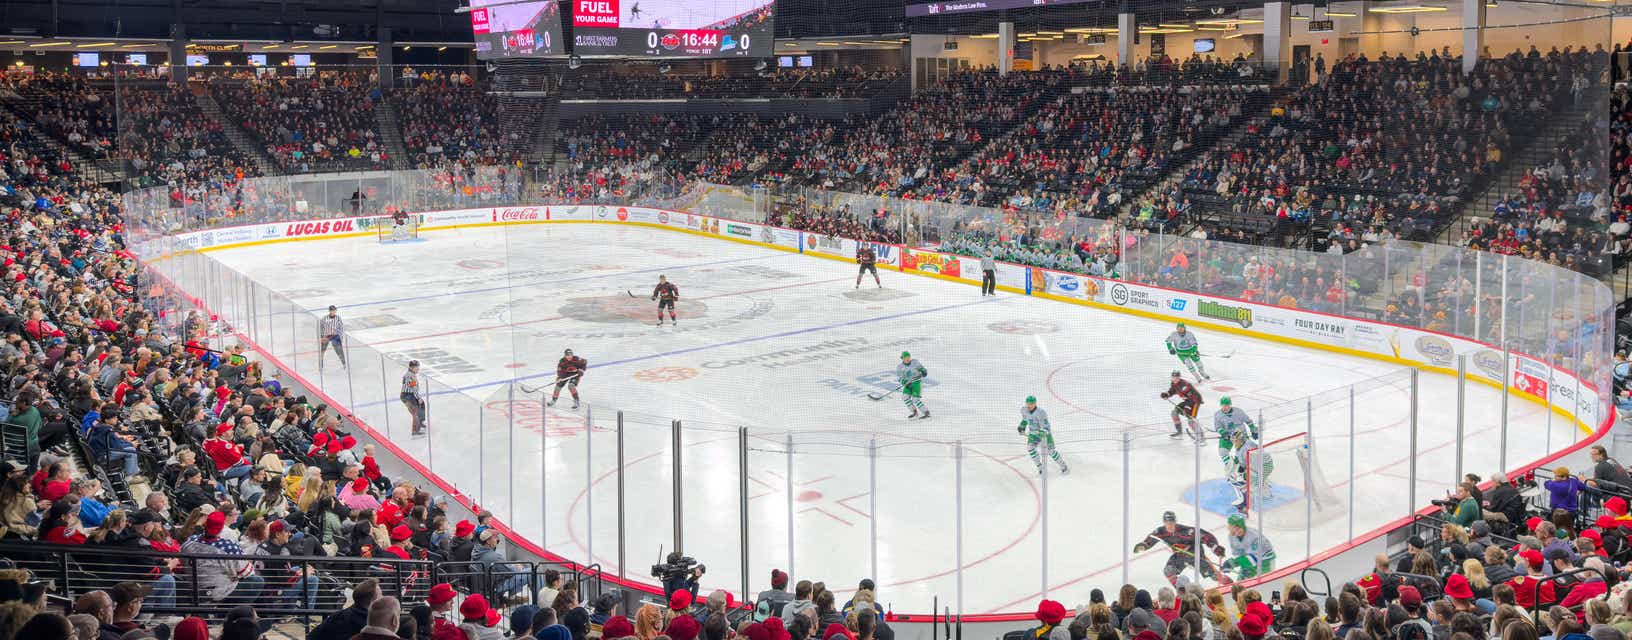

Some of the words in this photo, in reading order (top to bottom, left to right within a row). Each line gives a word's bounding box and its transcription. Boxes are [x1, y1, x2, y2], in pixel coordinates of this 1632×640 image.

[580, 1, 613, 13] FUEL
[473, 11, 486, 22] FUEL
[502, 35, 507, 50] 0
[517, 33, 534, 47] 16:44
[544, 31, 551, 48] 0
[647, 32, 658, 48] 0
[682, 33, 717, 46] 16:44
[740, 34, 750, 49] 0
[286, 222, 330, 236] LUCAS
[333, 220, 353, 232] OIL
[1114, 289, 1126, 300] SG
[1131, 290, 1149, 298] SPORT
[1295, 319, 1313, 329] FOUR
[1315, 322, 1329, 332] DAY
[1331, 324, 1345, 334] RAY
